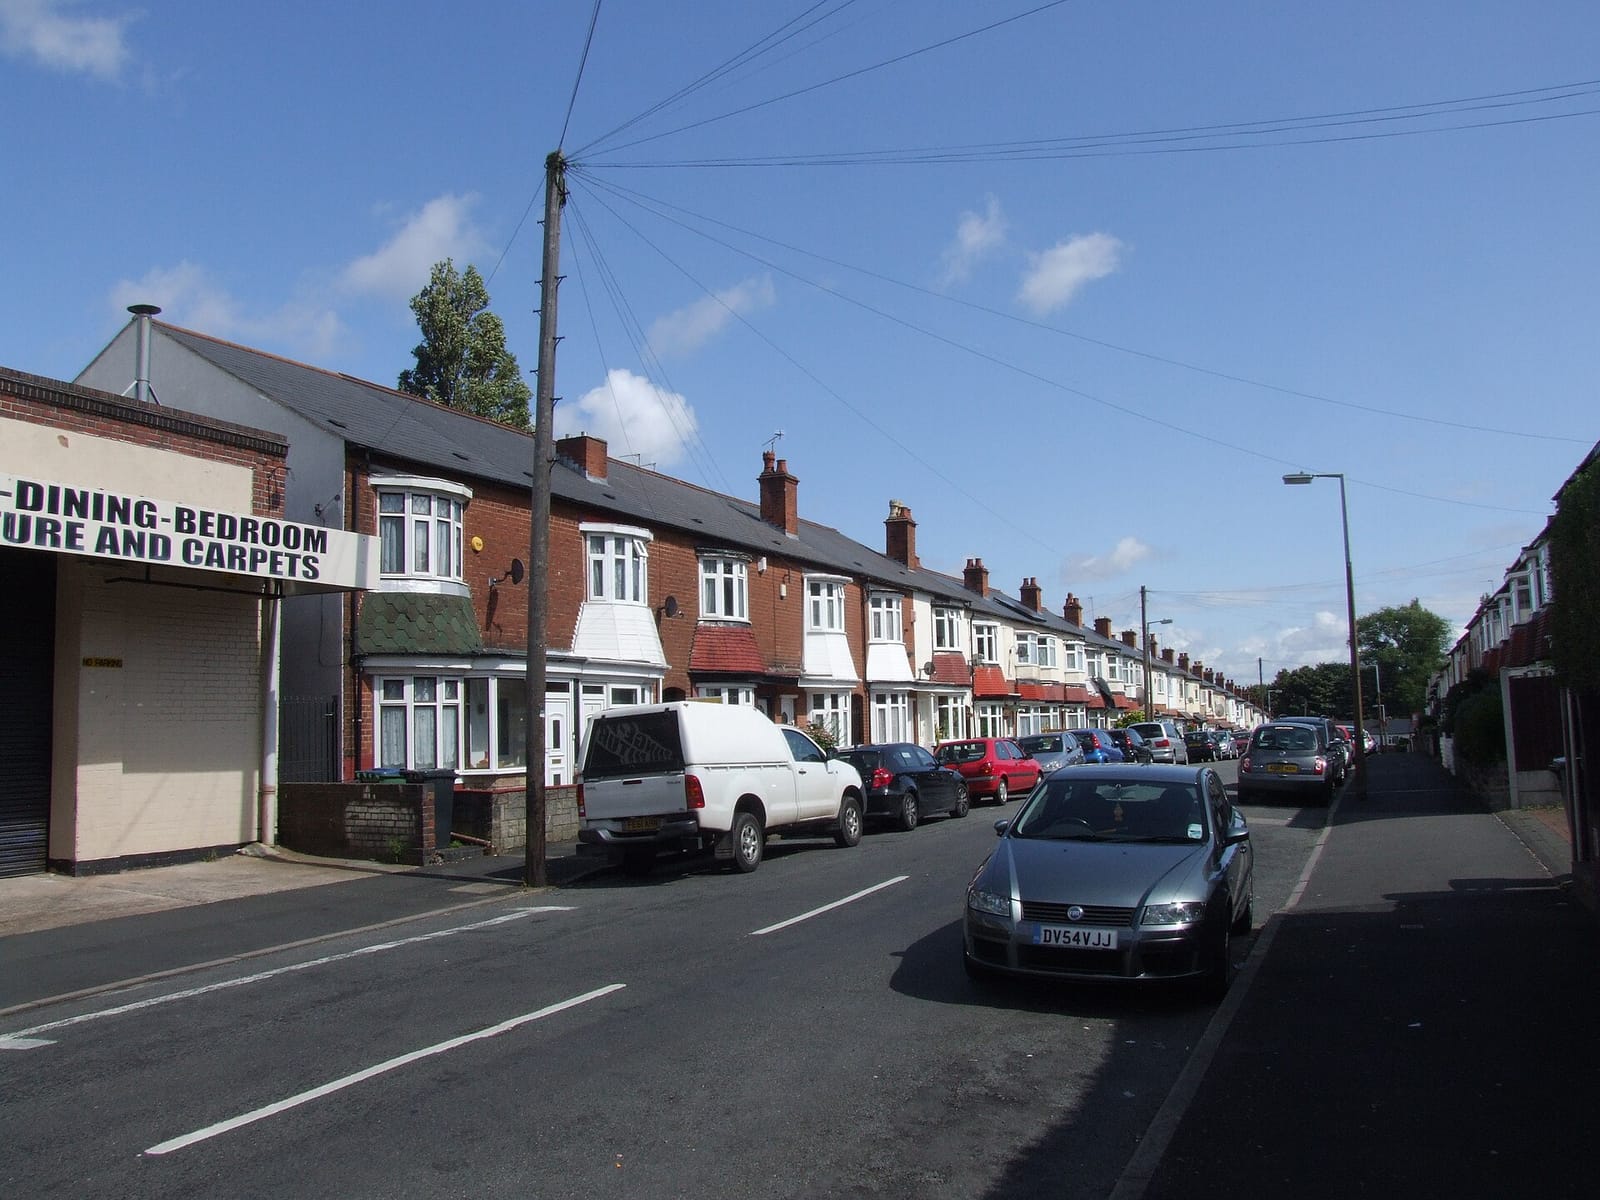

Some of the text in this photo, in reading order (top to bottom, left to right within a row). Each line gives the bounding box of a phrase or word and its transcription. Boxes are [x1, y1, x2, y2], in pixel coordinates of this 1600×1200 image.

[0, 511, 320, 580] URE AND CARPETS
